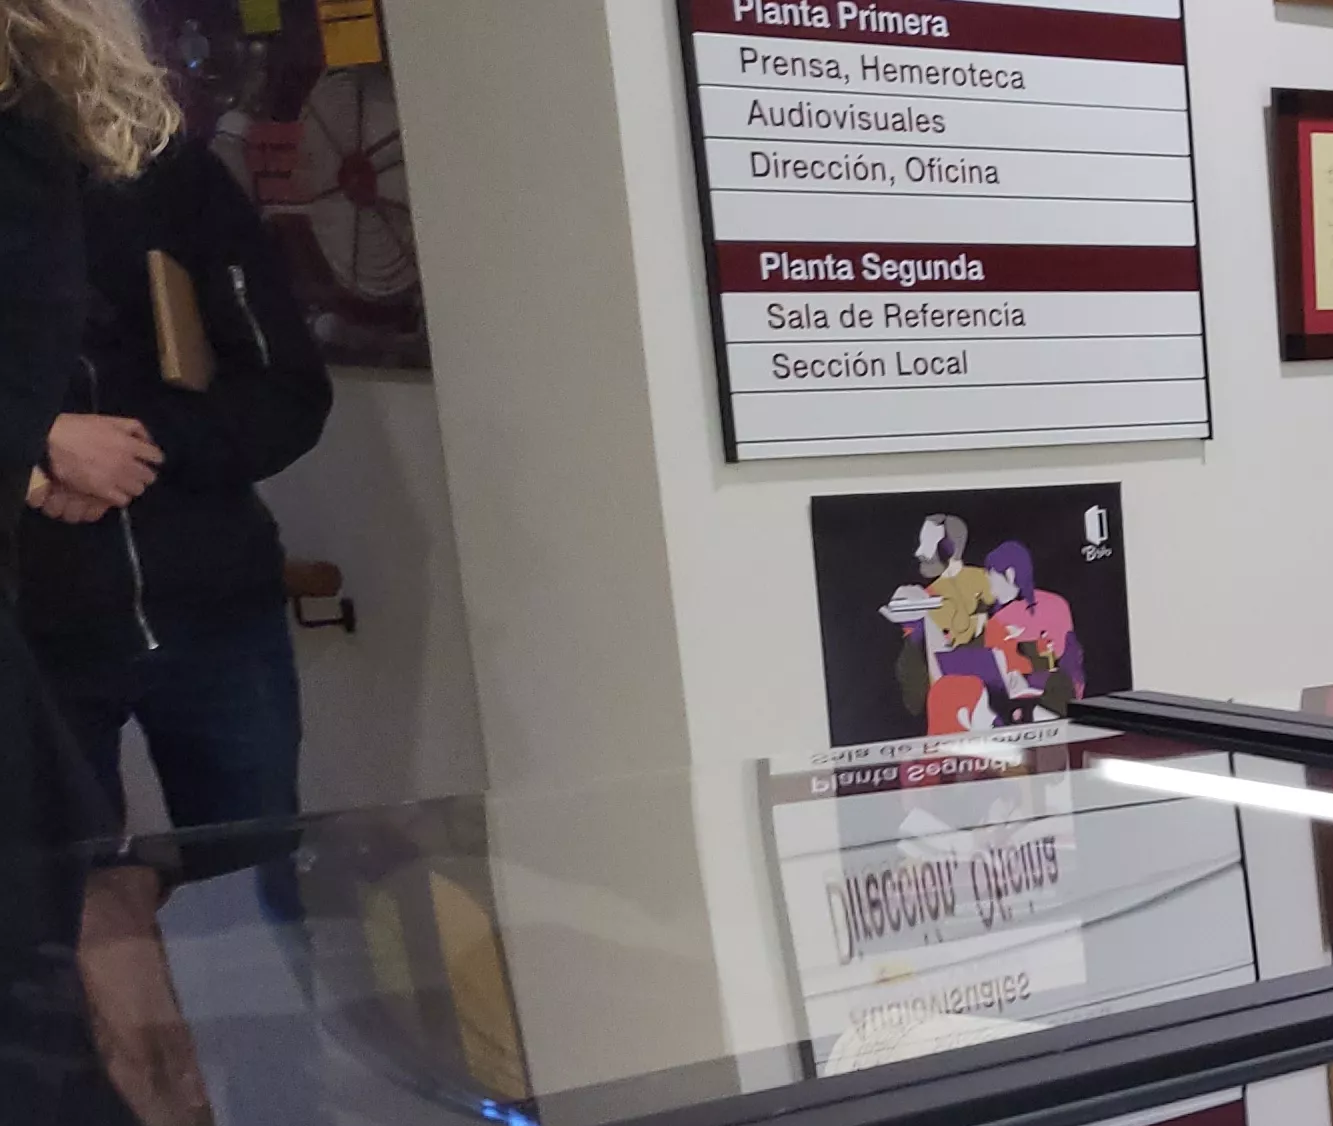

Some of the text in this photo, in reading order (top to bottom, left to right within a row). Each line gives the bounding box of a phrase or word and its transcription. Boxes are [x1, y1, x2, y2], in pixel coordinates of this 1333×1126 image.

[733, 0, 949, 38] Planta Primera
[739, 46, 1025, 90] Prensa, Hemeroteca
[747, 98, 946, 134] Audiovisuales
[750, 151, 1000, 185] Dirección, Oficina
[759, 251, 984, 287] Planta Segunda
[766, 302, 1026, 330] Sala de Referencia
[772, 350, 969, 380] Sección Local
